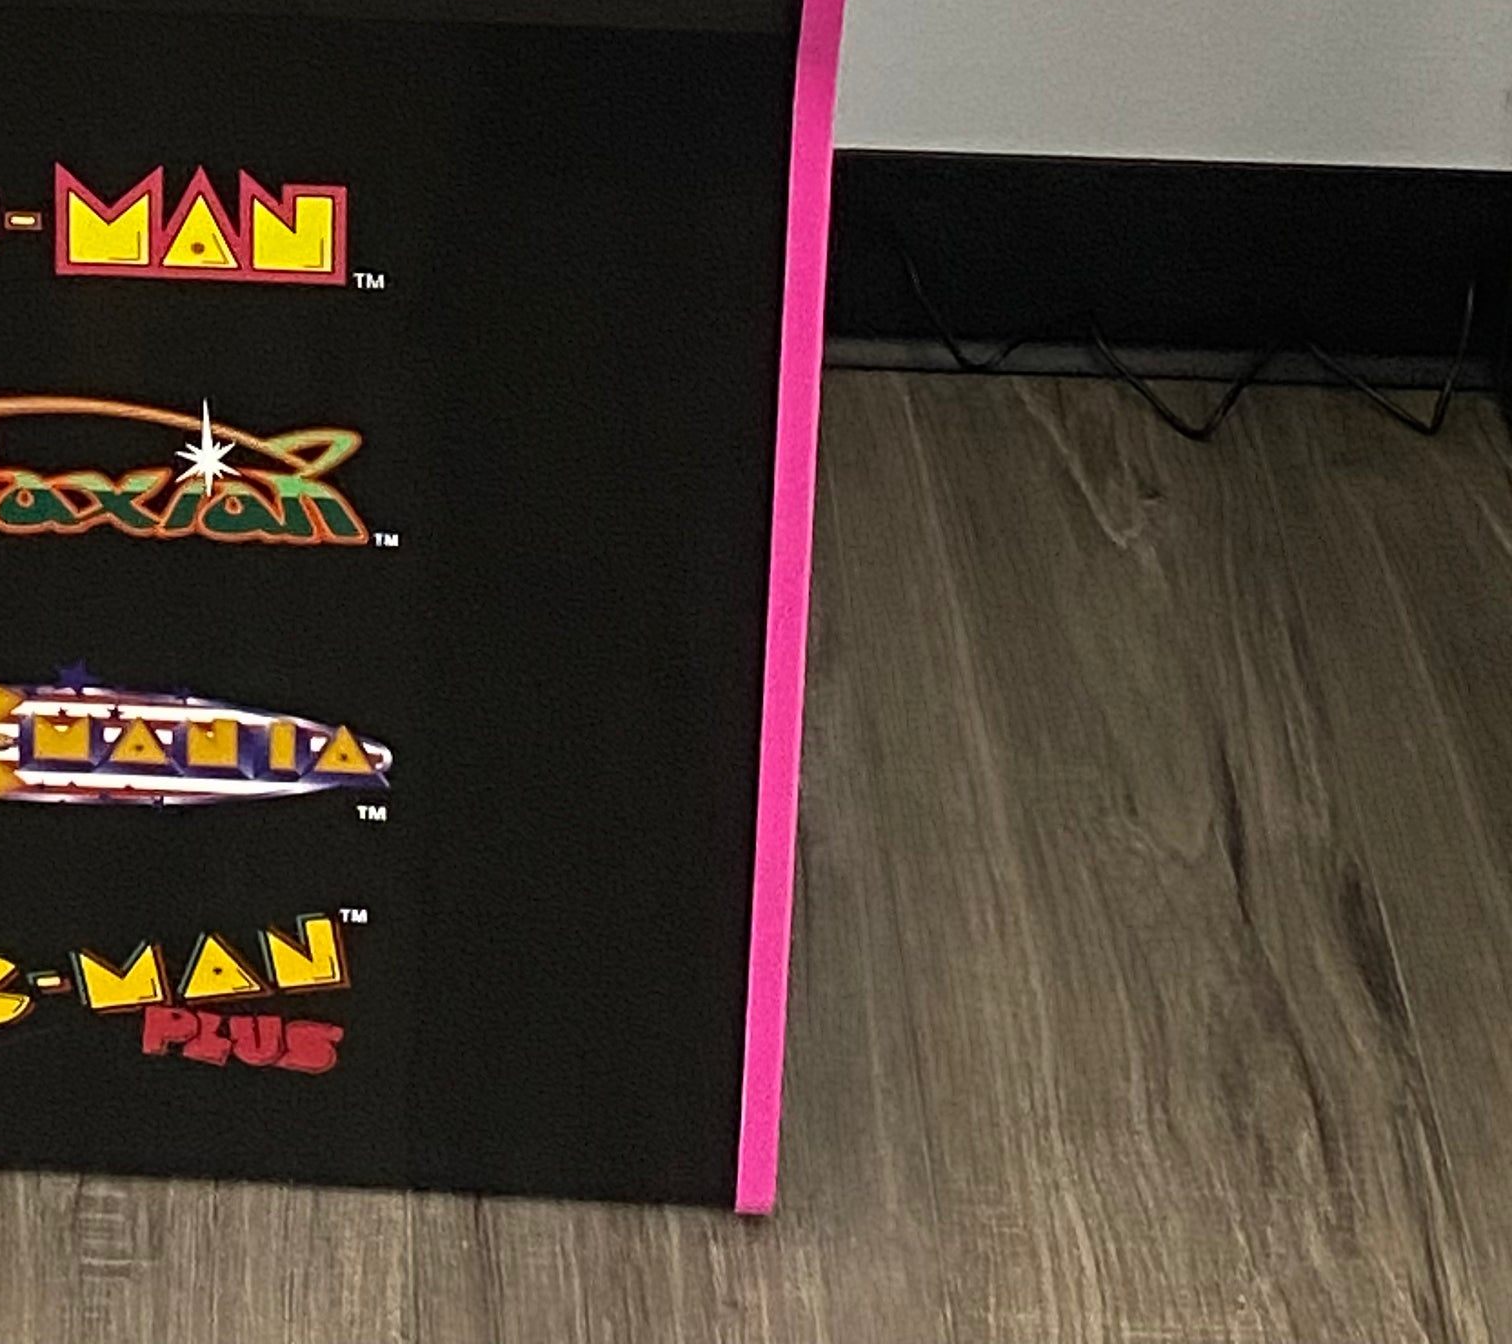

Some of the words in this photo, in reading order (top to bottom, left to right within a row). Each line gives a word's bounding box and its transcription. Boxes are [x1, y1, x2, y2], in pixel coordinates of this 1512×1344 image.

[353, 272, 386, 290] TM
[374, 532, 399, 547] TM
[357, 805, 387, 822] TM
[340, 908, 368, 924] TM
[142, 1005, 345, 1075] PLUS
